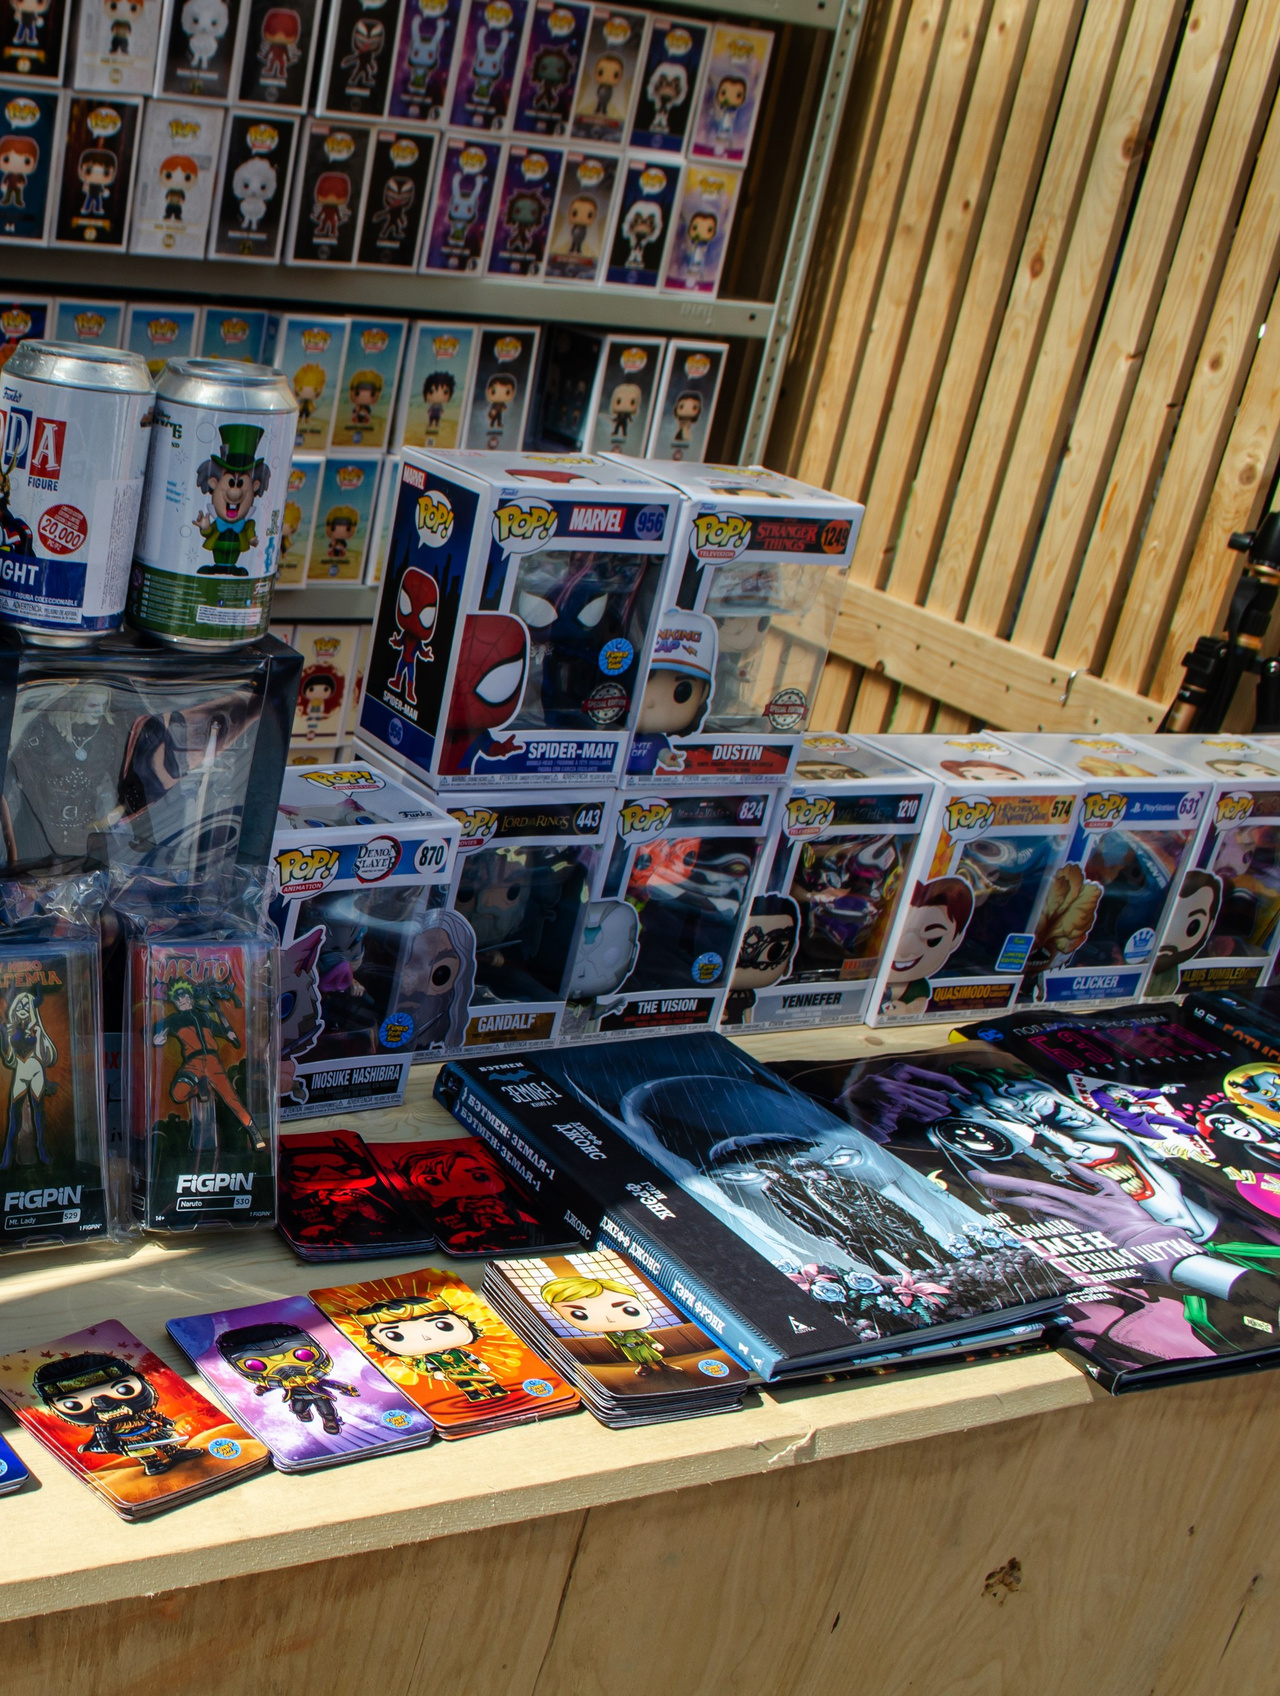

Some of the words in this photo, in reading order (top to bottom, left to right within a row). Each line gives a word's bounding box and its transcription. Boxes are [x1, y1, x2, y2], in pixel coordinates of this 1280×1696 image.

[27, 476, 59, 492] FIGURE
[402, 464, 427, 489] MARVEL
[418, 496, 455, 538] POP!
[493, 504, 558, 542] POP!
[569, 506, 626, 533] MARVEL
[636, 511, 664, 533] 956
[41, 518, 81, 548] 20,000
[693, 515, 753, 548] POP!
[755, 521, 818, 543] STRANGER
[700, 550, 735, 558] TELEVISION
[382, 691, 419, 722] SPIDER-MAN
[528, 741, 615, 760] SPIDER-MAN
[712, 745, 763, 761] DUSTIN
[739, 802, 763, 820] 824
[785, 799, 836, 826] POP!
[897, 800, 917, 818] 1210
[946, 800, 996, 831] POP!
[1050, 801, 1070, 818] 574
[1083, 796, 1128, 821] POP!
[1142, 803, 1176, 813] PlayStation
[1178, 799, 1200, 815] 631
[500, 814, 528, 831] LORD
[536, 814, 570, 829] RINGS
[576, 809, 600, 828] 443
[620, 803, 673, 836] POP!
[352, 857, 397, 874] SLAYER
[419, 845, 444, 866] 870
[274, 848, 341, 886] POP!
[282, 882, 322, 893] ANIMATION
[152, 958, 230, 984] NARUTO
[1181, 968, 1205, 981] ALBUS
[1072, 975, 1120, 990] CLICKER
[782, 992, 842, 1008] YENNEFER
[934, 986, 991, 1001] QUASIMODO
[637, 1001, 660, 1014] THE
[661, 998, 698, 1014] VISION
[477, 1016, 536, 1033] GANDALF
[311, 1070, 350, 1090] INOSUKE
[351, 1065, 401, 1086] HASHIBIRA
[478, 1062, 525, 1072] БЭТМЕН
[501, 1081, 563, 1104] ЗЕМЛЯ-1
[467, 1094, 511, 1138] БЭТМЕН:
[511, 1132, 556, 1181] ЗЕМЛЯ-1
[551, 1123, 608, 1161] ДЖОНС
[460, 1107, 501, 1150] БЭТМЕН:
[501, 1146, 542, 1192] ЗЕМЛЯ-1
[180, 1199, 203, 1208] Naruto
[235, 1198, 250, 1206] 530
[625, 1182, 677, 1221] ФРЭНК
[8, 1217, 19, 1226] Mt.
[20, 1216, 37, 1227] Lady
[64, 1211, 79, 1220] 529
[563, 1209, 592, 1241] ДЖОНС
[1131, 1237, 1204, 1263] ШУТКА
[628, 1241, 662, 1276] ДЖОНС
[672, 1279, 697, 1308] ГЭРИ
[694, 1301, 726, 1335] ФРЭНК
